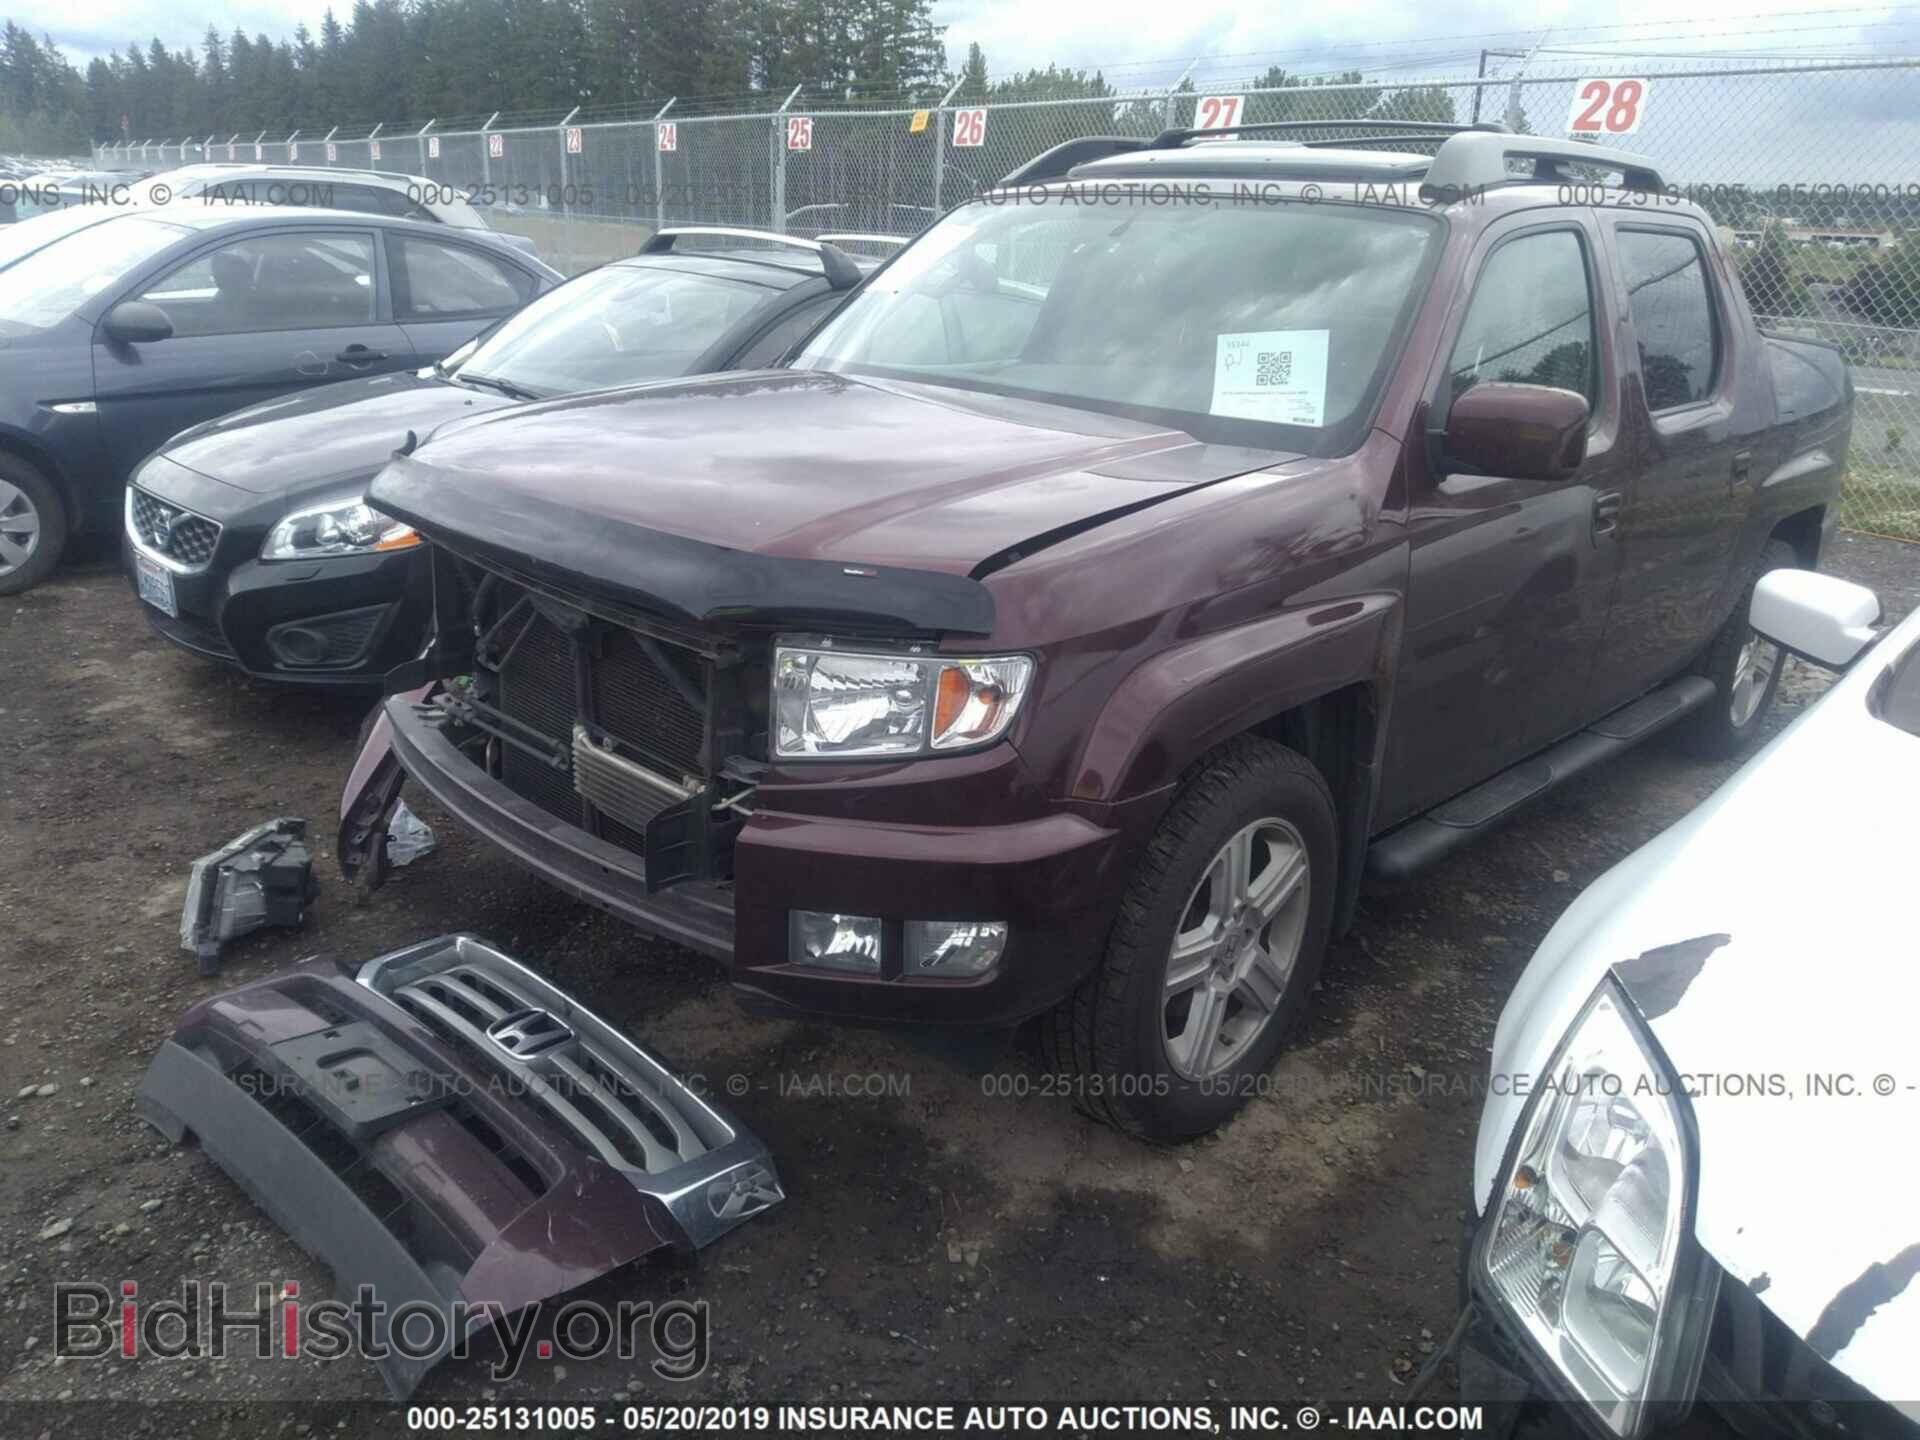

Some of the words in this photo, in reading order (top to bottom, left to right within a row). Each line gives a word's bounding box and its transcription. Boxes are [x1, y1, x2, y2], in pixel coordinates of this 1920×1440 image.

[1201, 98, 1238, 138] 27
[1573, 80, 1642, 132] 28
[660, 124, 675, 149] 24
[789, 118, 810, 148] 25
[955, 111, 984, 145] 26
